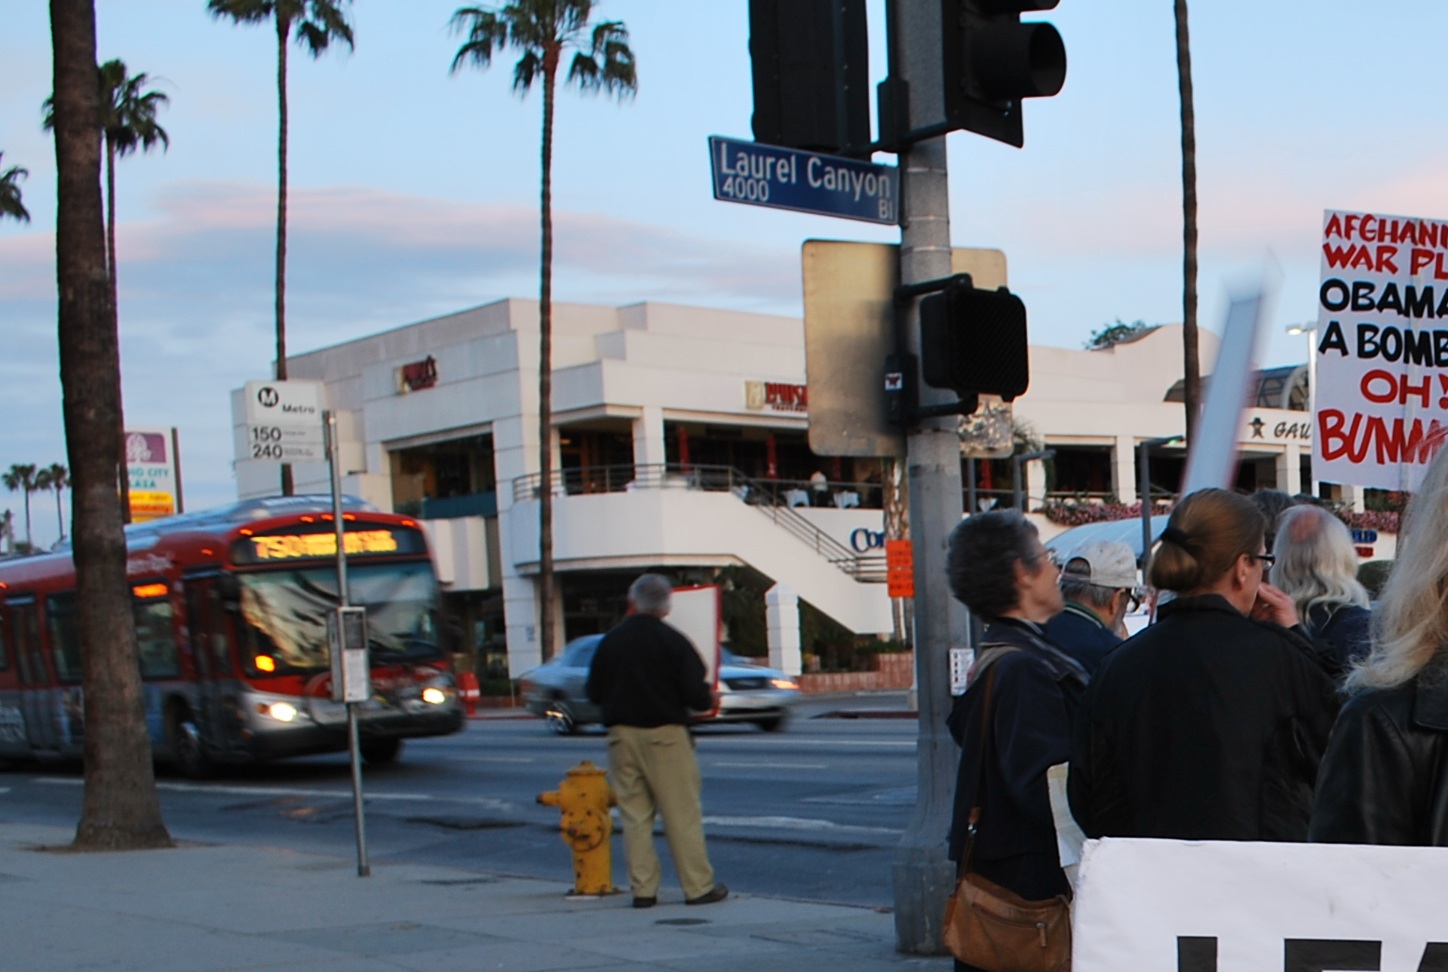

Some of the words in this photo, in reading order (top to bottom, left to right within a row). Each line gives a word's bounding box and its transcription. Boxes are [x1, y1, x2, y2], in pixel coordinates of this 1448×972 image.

[721, 143, 796, 184] Laurel
[807, 157, 890, 201] Canyon
[722, 177, 769, 201] 4000
[878, 199, 893, 219] Bl
[1322, 242, 1399, 275] WAR
[1318, 321, 1349, 357] A
[282, 404, 315, 413] Metro
[253, 427, 282, 441] 150
[1274, 422, 1311, 439] GAU
[253, 444, 283, 459] 240
